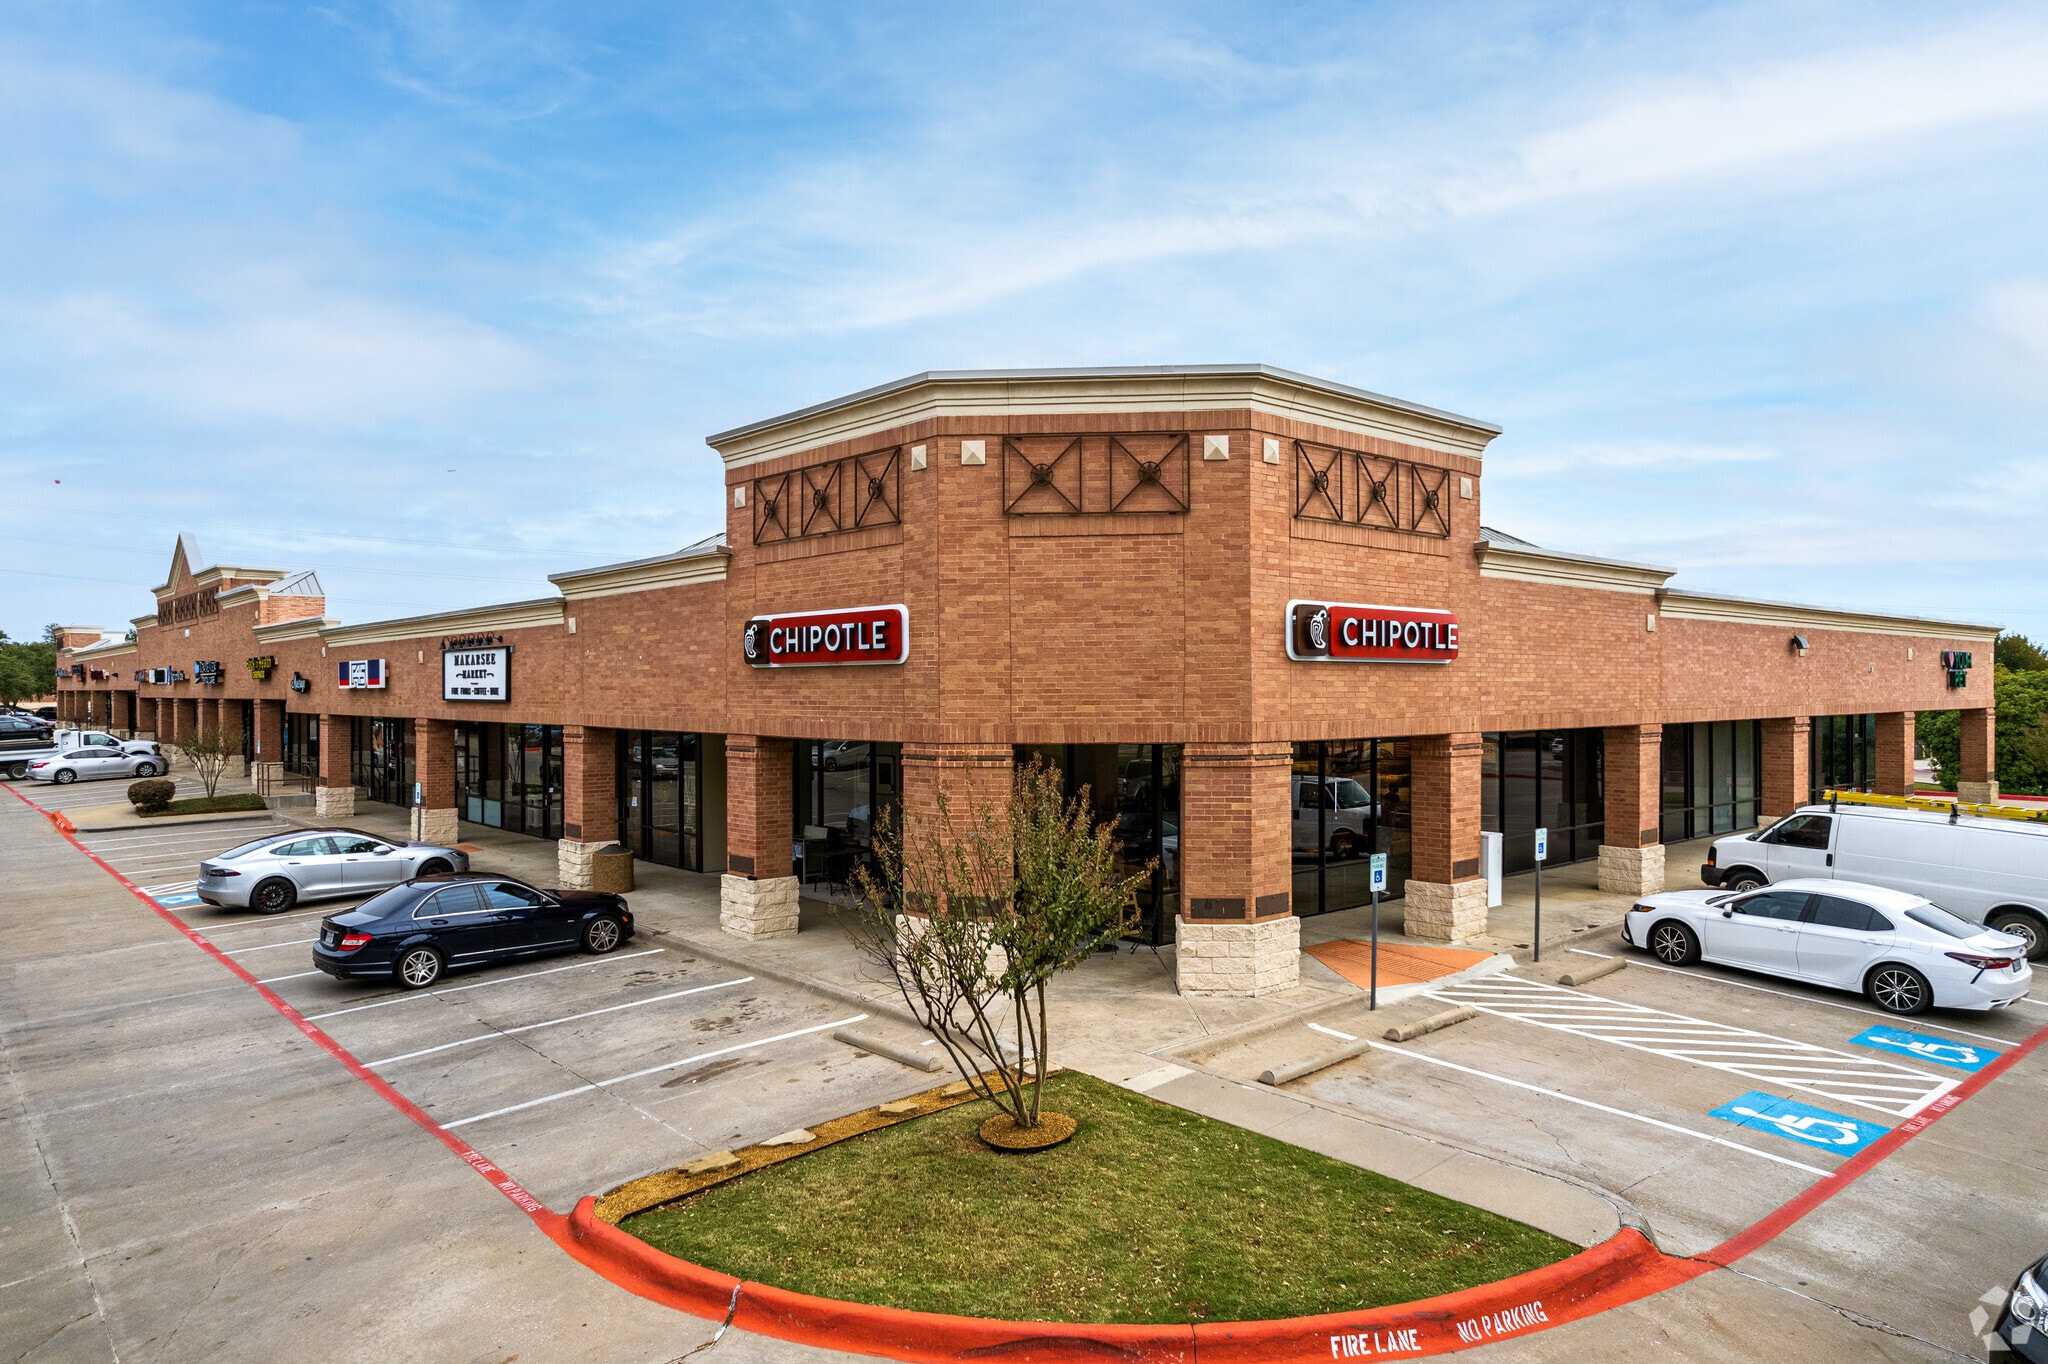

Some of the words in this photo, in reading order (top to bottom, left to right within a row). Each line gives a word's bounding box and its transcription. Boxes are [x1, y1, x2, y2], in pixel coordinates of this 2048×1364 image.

[770, 620, 886, 654] CHIPOTLE
[1343, 617, 1459, 649] CHIPOTLE
[454, 653, 496, 666] MAKARSEE
[462, 669, 487, 679] MARKET
[1330, 1333, 1372, 1359] FIRE
[1374, 1328, 1422, 1353] LANE
[1456, 1318, 1483, 1343] NO
[1482, 1300, 1550, 1337] PARKING
